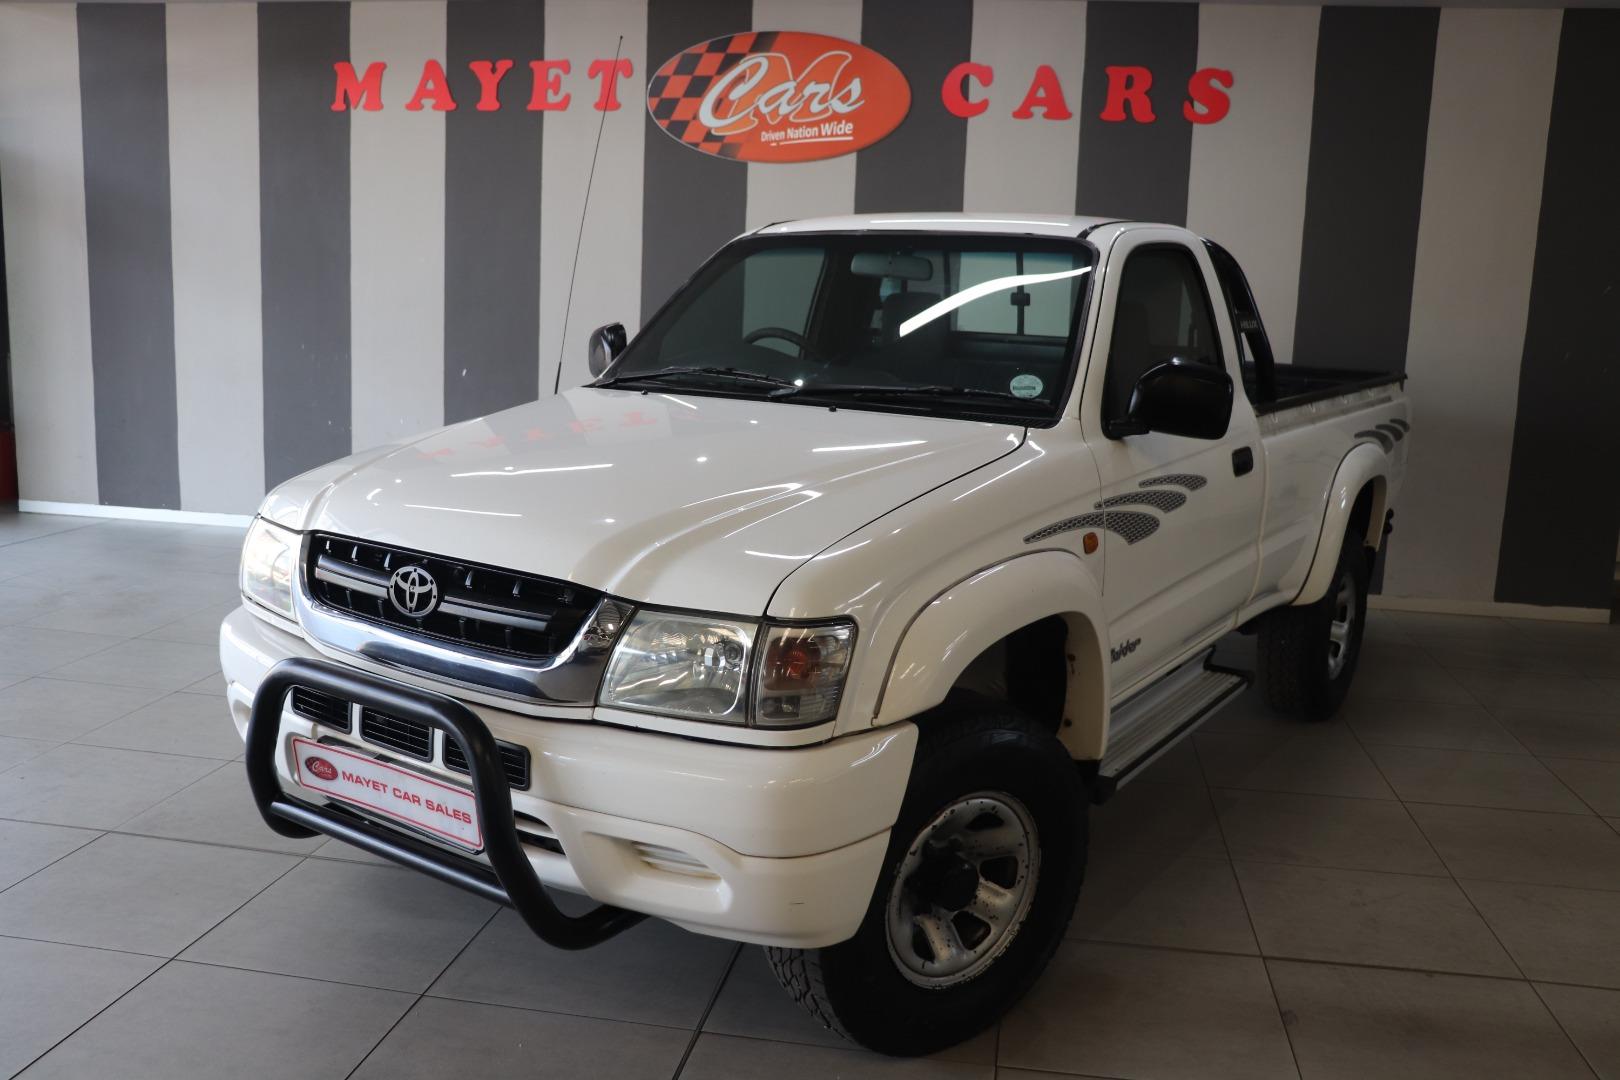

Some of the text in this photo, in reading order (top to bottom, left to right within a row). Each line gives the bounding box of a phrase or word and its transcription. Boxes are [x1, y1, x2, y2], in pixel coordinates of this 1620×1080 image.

[330, 59, 1235, 125] MAYET CARS
[699, 56, 865, 128] Cars
[760, 120, 854, 142] Driven Nation Wide
[341, 770, 472, 825] MAYET CAR SALES
